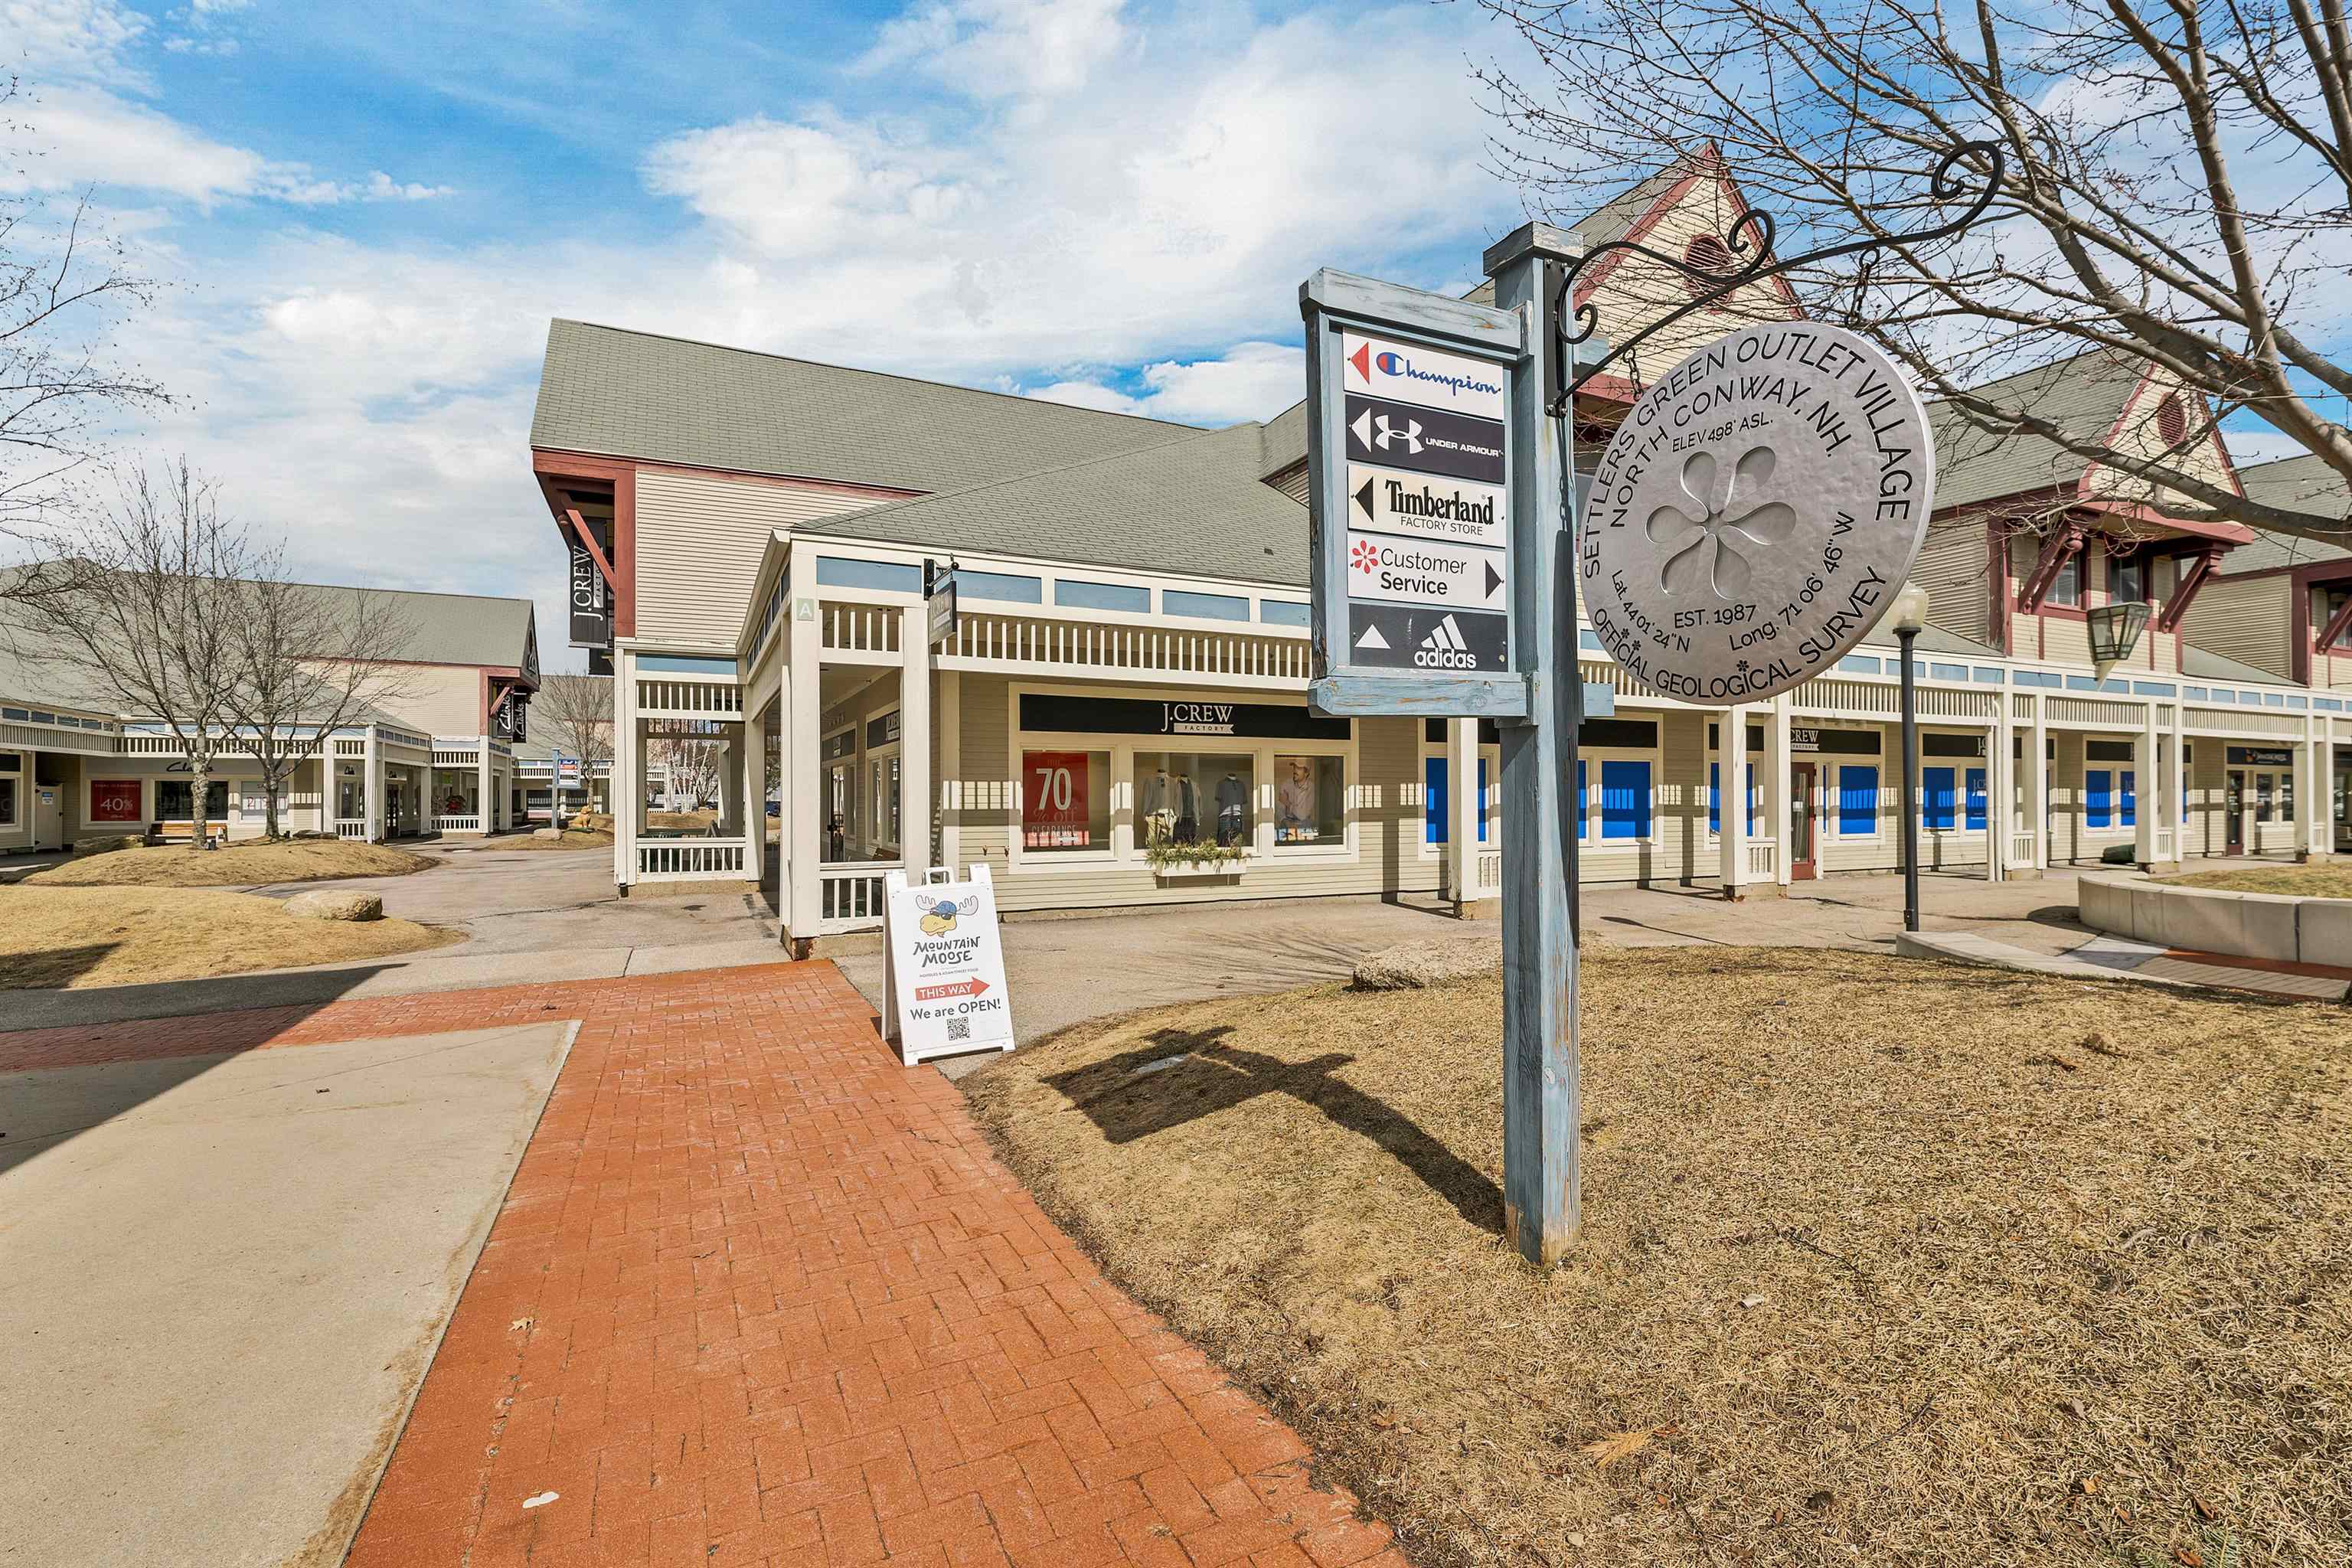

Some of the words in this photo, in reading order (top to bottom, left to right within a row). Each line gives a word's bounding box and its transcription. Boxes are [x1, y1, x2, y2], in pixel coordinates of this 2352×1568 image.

[1376, 351, 1501, 397] Champion
[1671, 429, 1707, 452] ELEV
[1739, 411, 1773, 433] ASL.
[1425, 437, 1459, 450] UNDER
[1459, 443, 1501, 458] ARMOUR
[1585, 430, 1635, 579] SETTLERS
[1636, 345, 1726, 426] GREEN
[1736, 332, 1866, 380] OUTLET
[1854, 368, 1913, 521] VILLAGE
[1610, 425, 1669, 528] NORTH
[1674, 374, 1811, 427] CONWAY,
[1806, 400, 1852, 458] NH.
[1384, 479, 1494, 526] Timberland
[1400, 516, 1447, 531] FACTORY
[1450, 522, 1483, 536] STORE
[1380, 547, 1467, 574] Customer
[573, 544, 604, 622] J.CREW
[1380, 571, 1448, 596] Service
[1612, 569, 1628, 601] Lat.
[1622, 601, 1639, 622] 44
[799, 603, 813, 617] A
[1674, 609, 1710, 629] EST.
[1713, 603, 1757, 626] 1987
[1593, 608, 1650, 683] OFFICIAL
[1655, 658, 1802, 699] GEOLOGICAL
[1798, 565, 1887, 665] SURVEY
[1729, 620, 1780, 652] Long.
[1777, 603, 1803, 626] 71
[1413, 647, 1478, 669] adidas
[1160, 703, 1233, 733] J.CREW
[1790, 729, 1819, 743] CREW
[1035, 767, 1072, 811] 70
[100, 798, 136, 812] 40%
[921, 950, 973, 968] MOOSE
[920, 988, 946, 999] THIS
[948, 983, 972, 995] WAY
[910, 1008, 931, 1021] We
[934, 1007, 955, 1018] are
[958, 998, 1001, 1014] OPEN!
